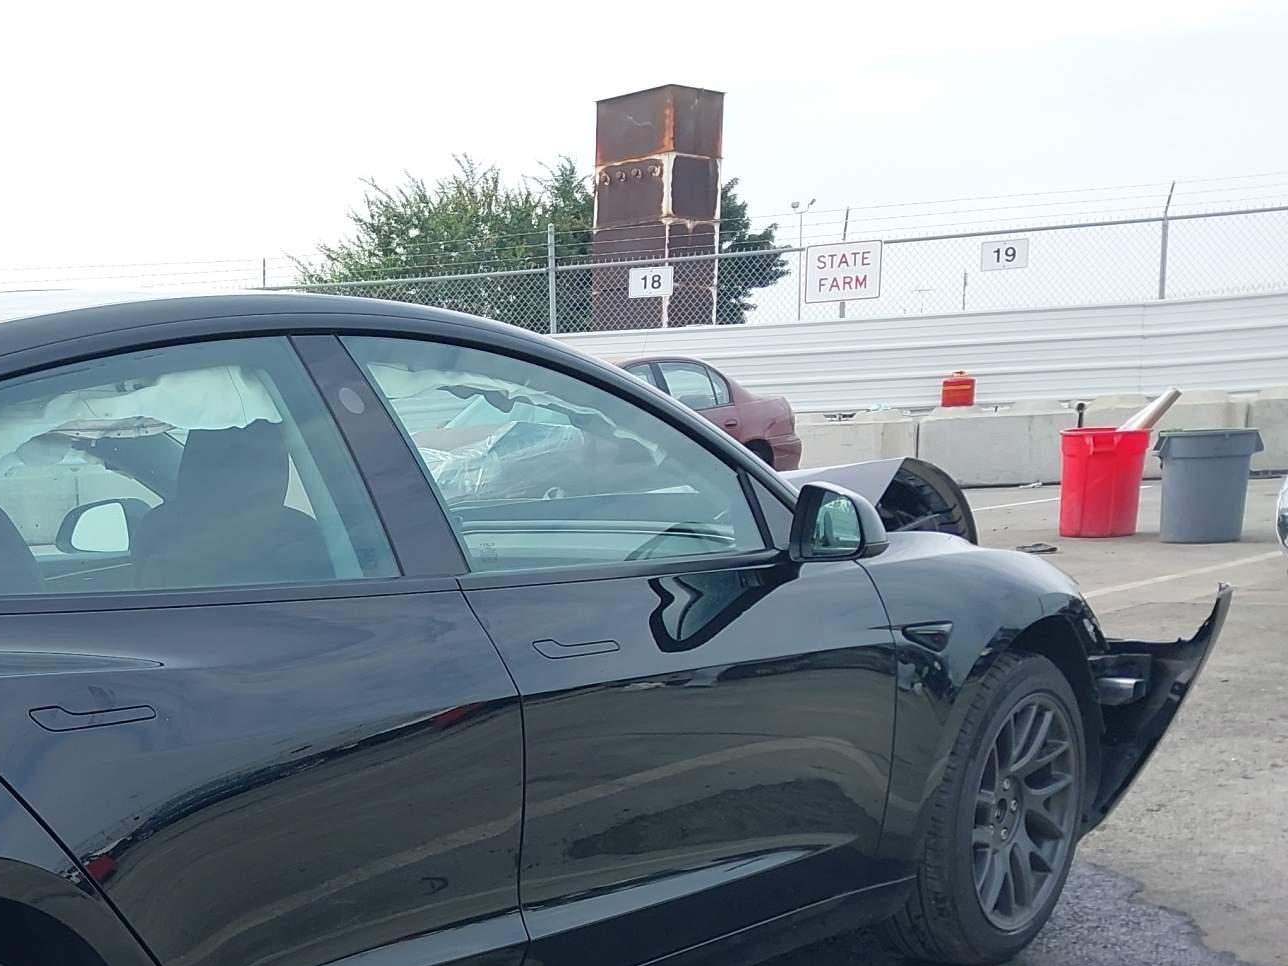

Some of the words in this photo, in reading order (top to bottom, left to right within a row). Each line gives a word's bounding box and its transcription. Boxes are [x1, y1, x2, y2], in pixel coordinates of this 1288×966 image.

[817, 251, 872, 271] STATE
[992, 246, 1016, 263] 19
[640, 274, 662, 290] 18
[818, 274, 868, 293] FARM
